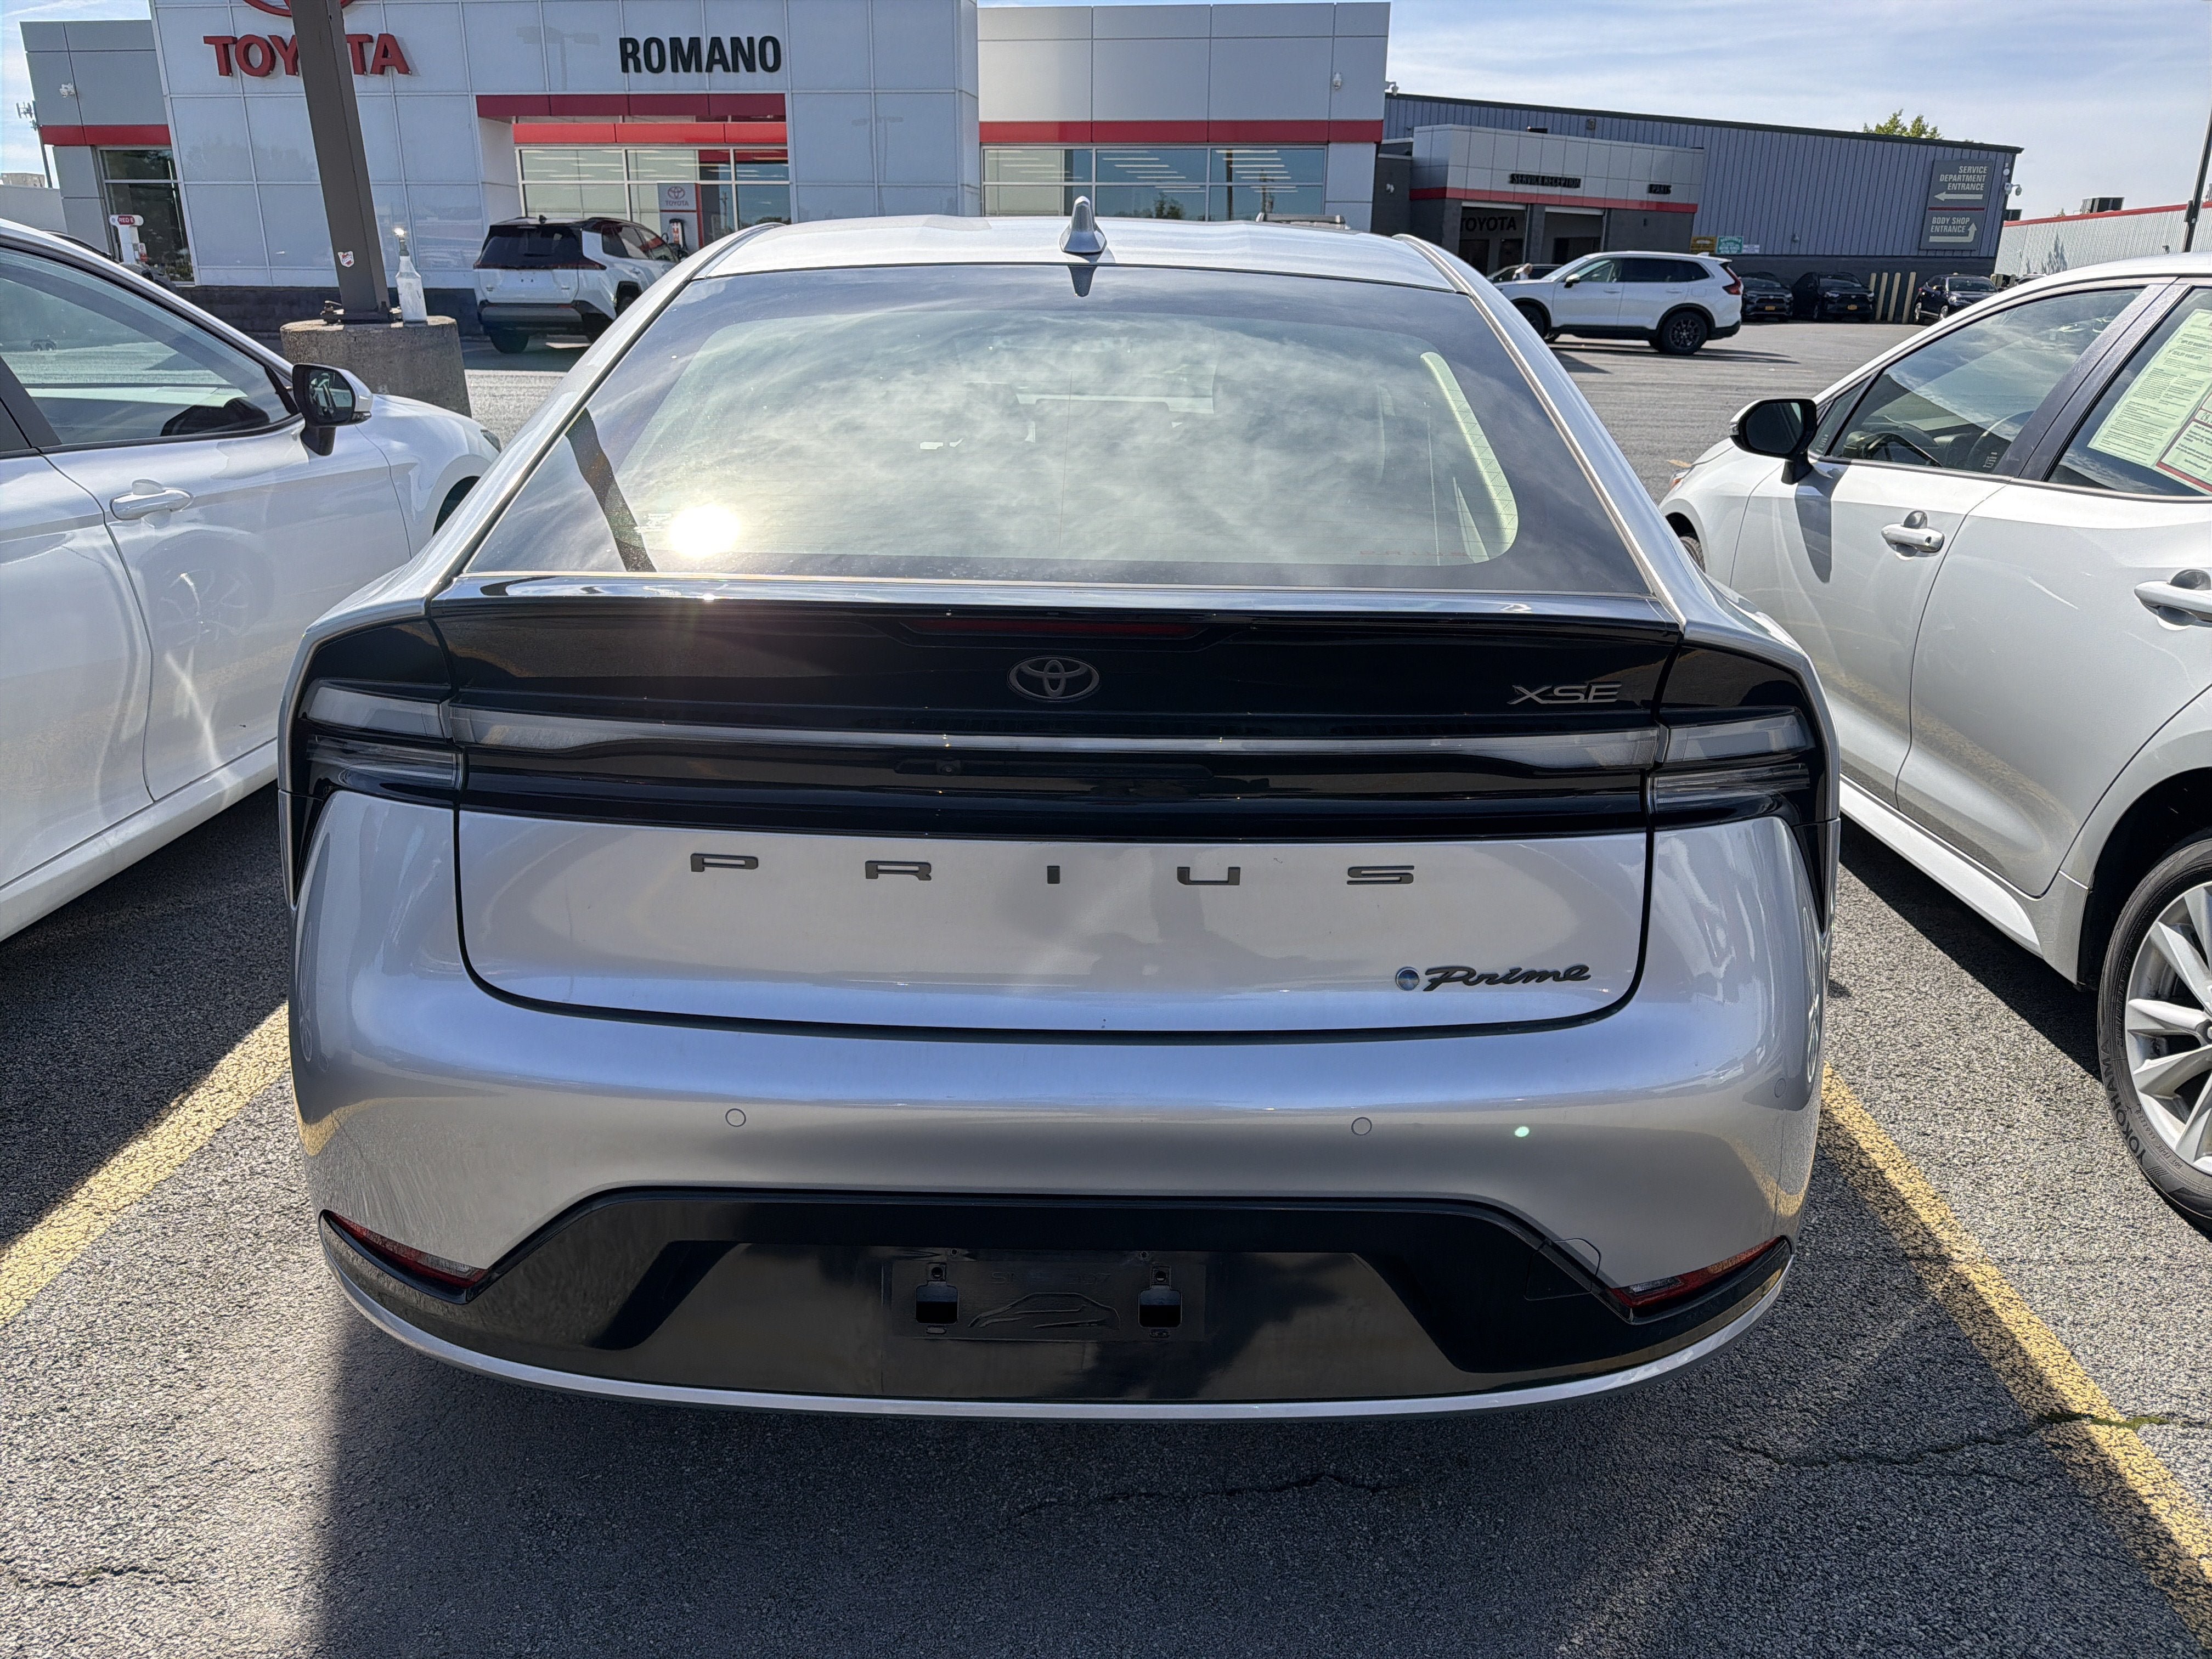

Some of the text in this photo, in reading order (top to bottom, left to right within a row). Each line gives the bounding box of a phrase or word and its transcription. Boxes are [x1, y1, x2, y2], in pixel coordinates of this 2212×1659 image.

[203, 33, 411, 76] TOYTA
[619, 36, 782, 74] ROMANO
[1507, 684, 1622, 704] XSE
[690, 853, 1414, 885] PRIUS
[1423, 964, 1592, 991] Prime
[2101, 1040, 2146, 1166] YOKOHAMA
